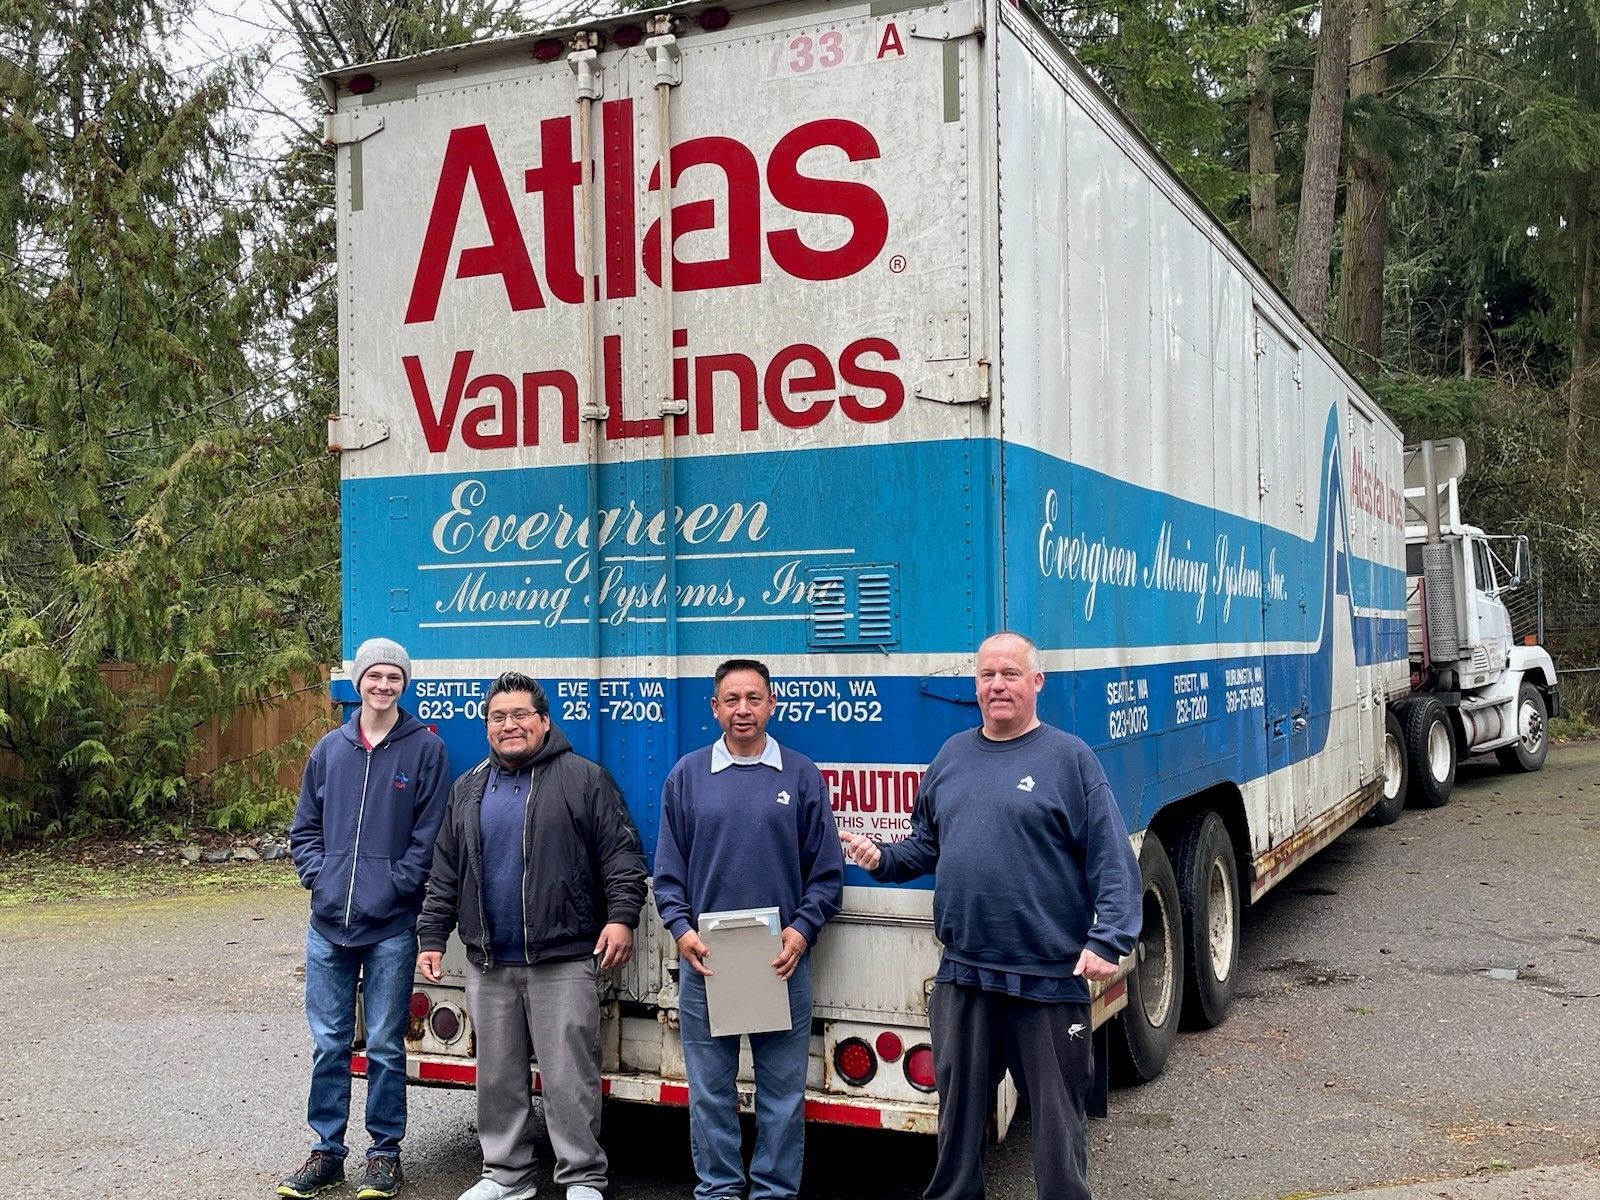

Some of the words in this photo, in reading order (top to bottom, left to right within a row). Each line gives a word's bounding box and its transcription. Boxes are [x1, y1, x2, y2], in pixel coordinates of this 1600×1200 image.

[404, 98, 889, 324] Atlas
[402, 350, 579, 453] Van
[603, 328, 905, 440] Lines
[432, 479, 770, 584] Evergreen
[1039, 488, 1138, 622] Evergreen
[1143, 520, 1209, 624] Moving
[436, 571, 571, 628] Moving
[415, 682, 485, 700] SEATTLE,
[557, 681, 634, 700] EVEETT,
[639, 681, 665, 698] WA
[770, 680, 841, 700] INGTON,
[849, 680, 878, 697] WA
[418, 701, 486, 720] 623-00
[562, 700, 662, 721] 25-7200
[775, 701, 883, 722] 757-1052
[1109, 705, 1148, 740] 623-0073
[820, 769, 926, 814] CAUTIO
[834, 816, 864, 829] THIS
[871, 817, 914, 830] VEHIC
